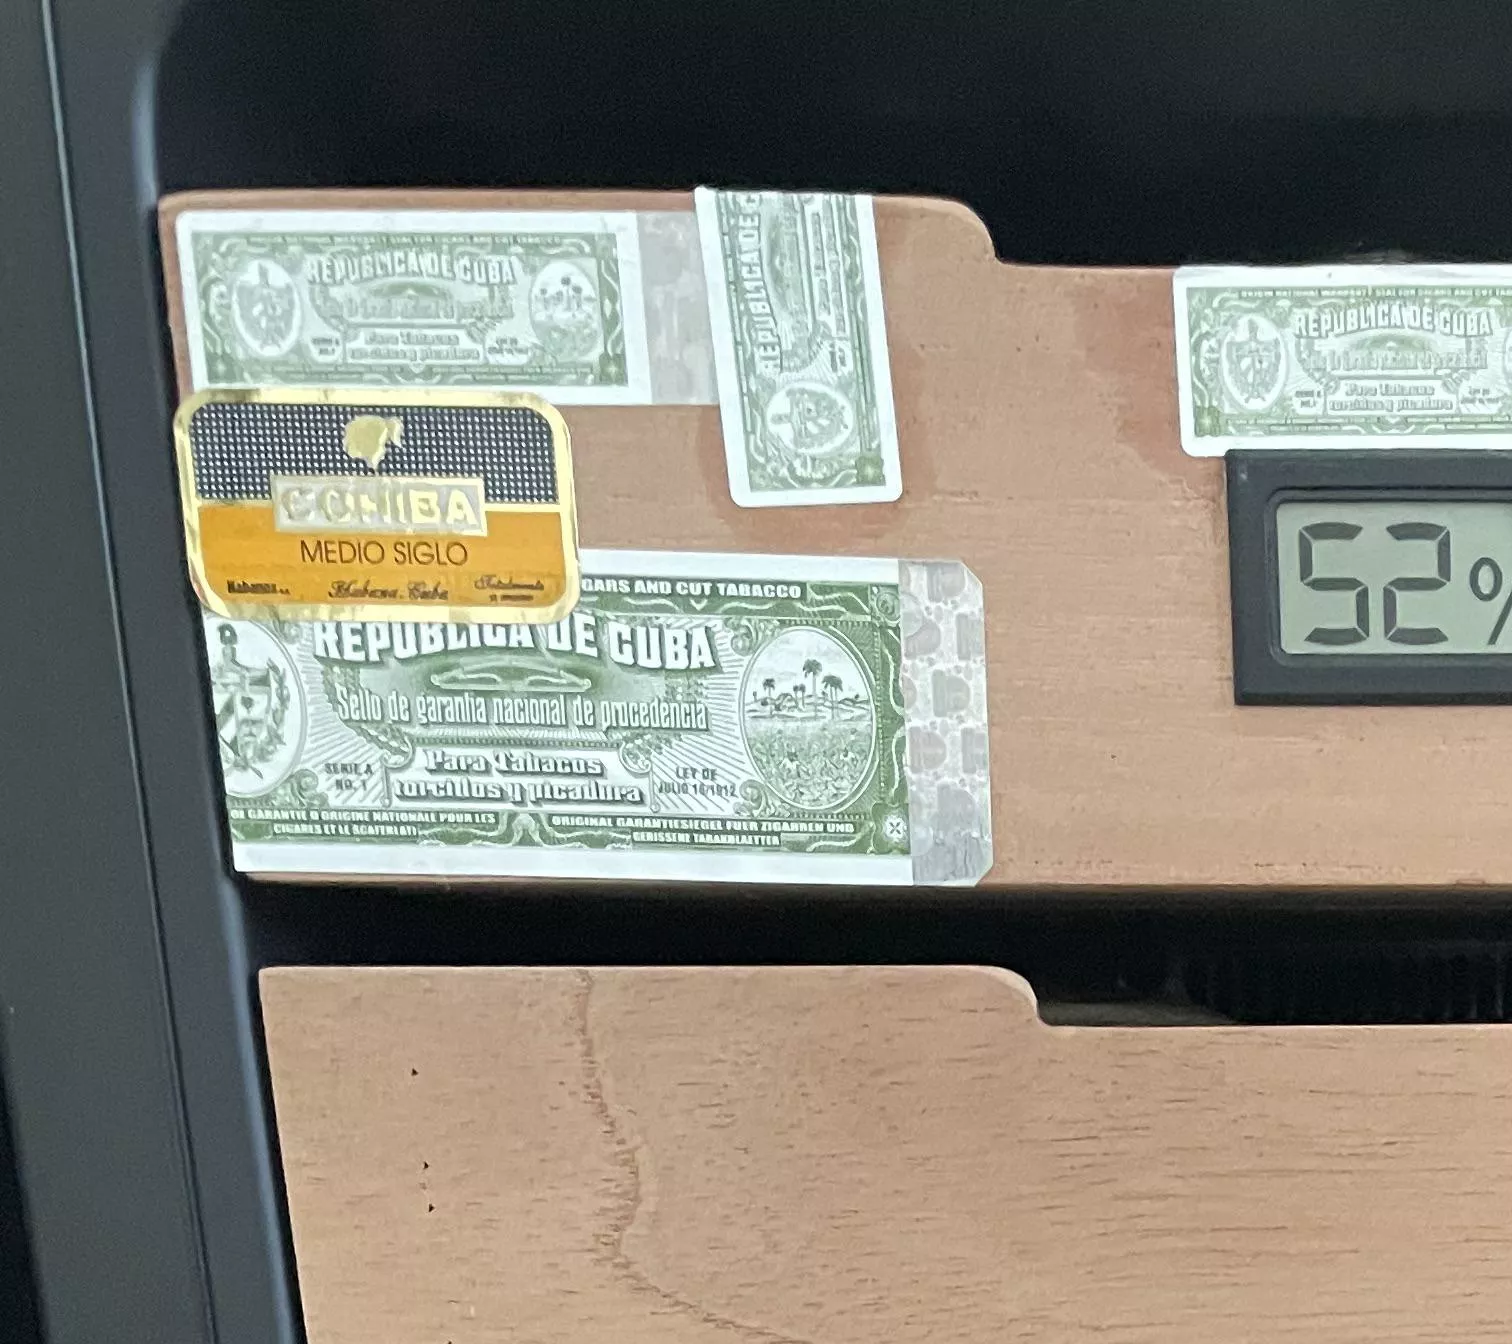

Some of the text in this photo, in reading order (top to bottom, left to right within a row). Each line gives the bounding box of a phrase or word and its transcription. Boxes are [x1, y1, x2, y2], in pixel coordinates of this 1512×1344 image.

[304, 250, 518, 284] REPUBLICA DE CUBA
[1293, 304, 1494, 337] REPUBLICA DE CUBA
[282, 486, 478, 526] COHIBA
[300, 539, 468, 566] MEDIO SIGLO
[635, 580, 671, 594] AND
[676, 582, 712, 596] CUT
[548, 612, 598, 658] DE
[609, 623, 717, 669] CUBA
[336, 684, 382, 722] Sello
[388, 691, 409, 721] de
[493, 694, 566, 726] nacional
[572, 697, 594, 727] de
